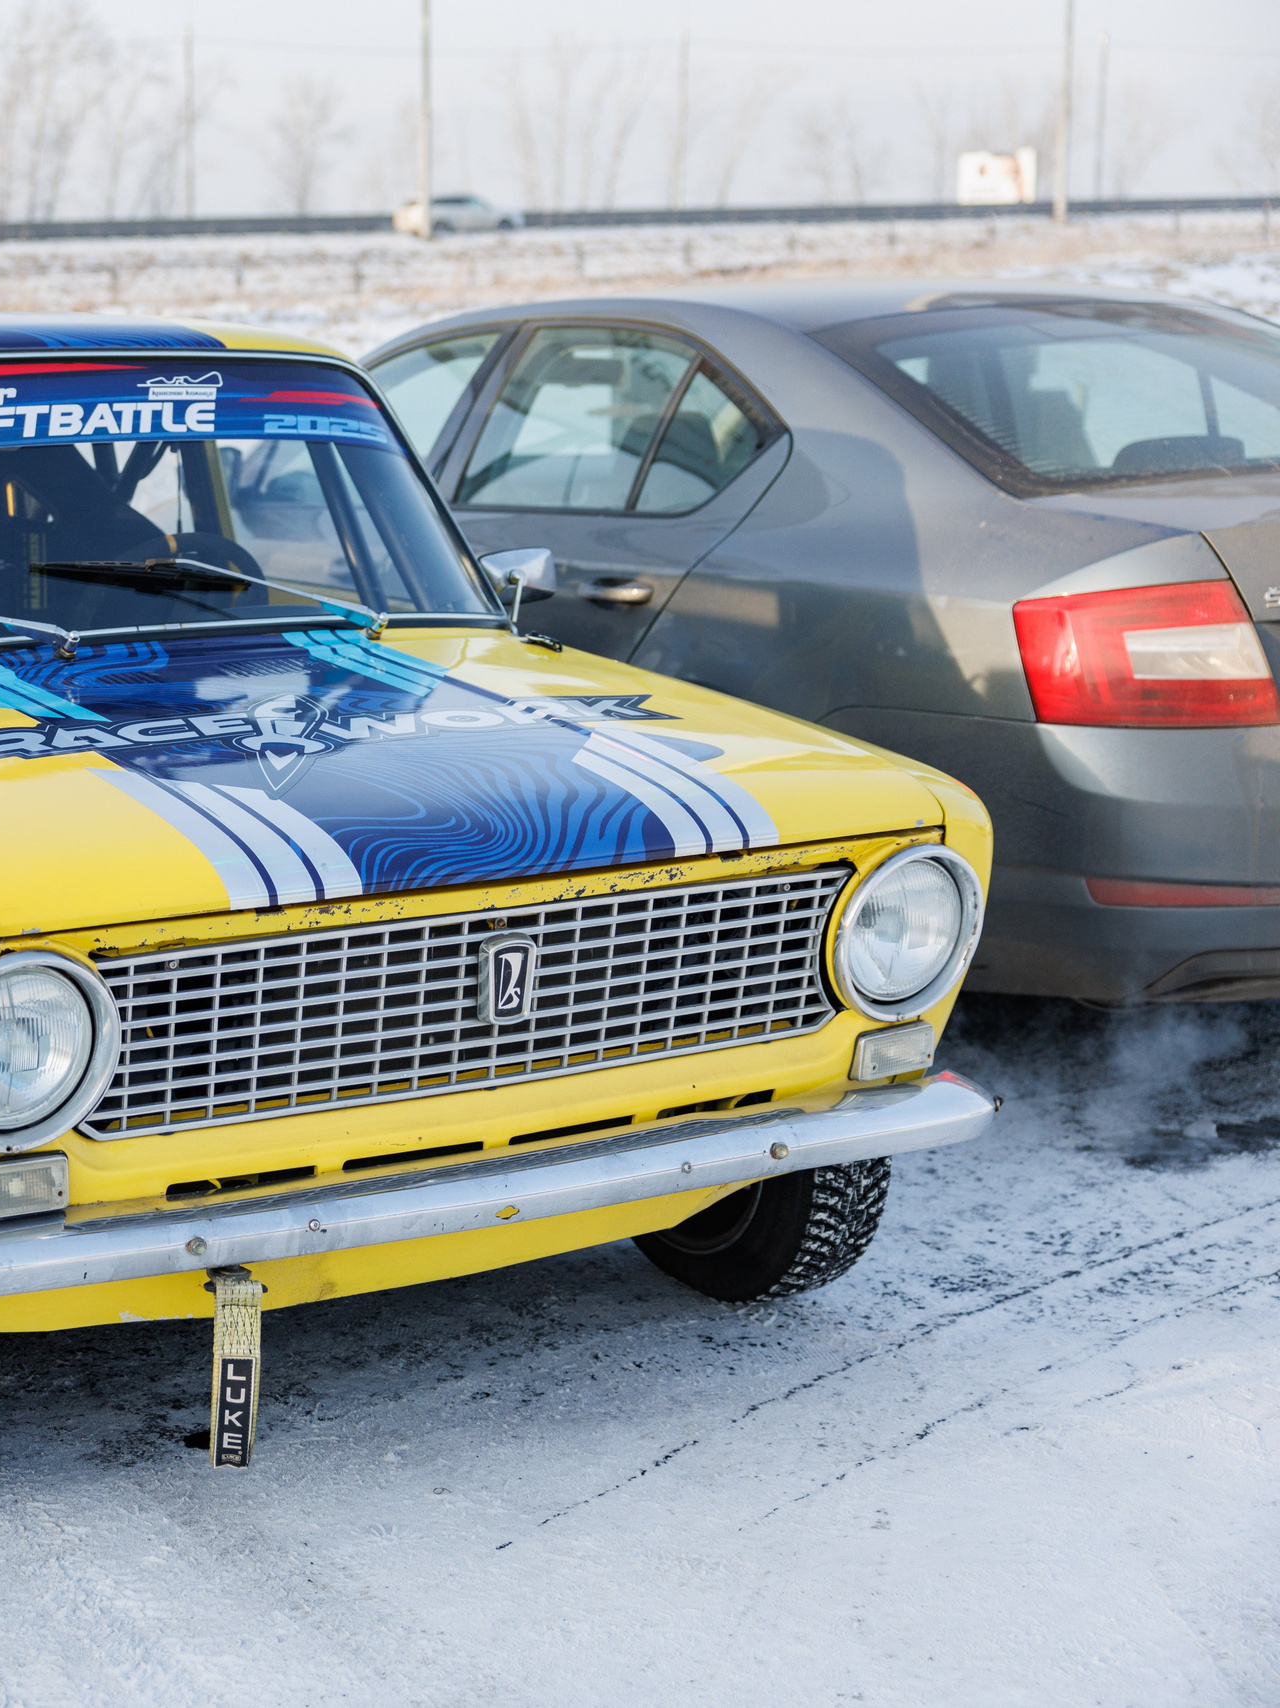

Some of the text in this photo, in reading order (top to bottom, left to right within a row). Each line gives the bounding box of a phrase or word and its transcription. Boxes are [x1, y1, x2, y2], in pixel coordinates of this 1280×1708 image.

[263, 414, 388, 443] 2025
[320, 699, 639, 739] WORK
[222, 1363, 247, 1450] LUKE
